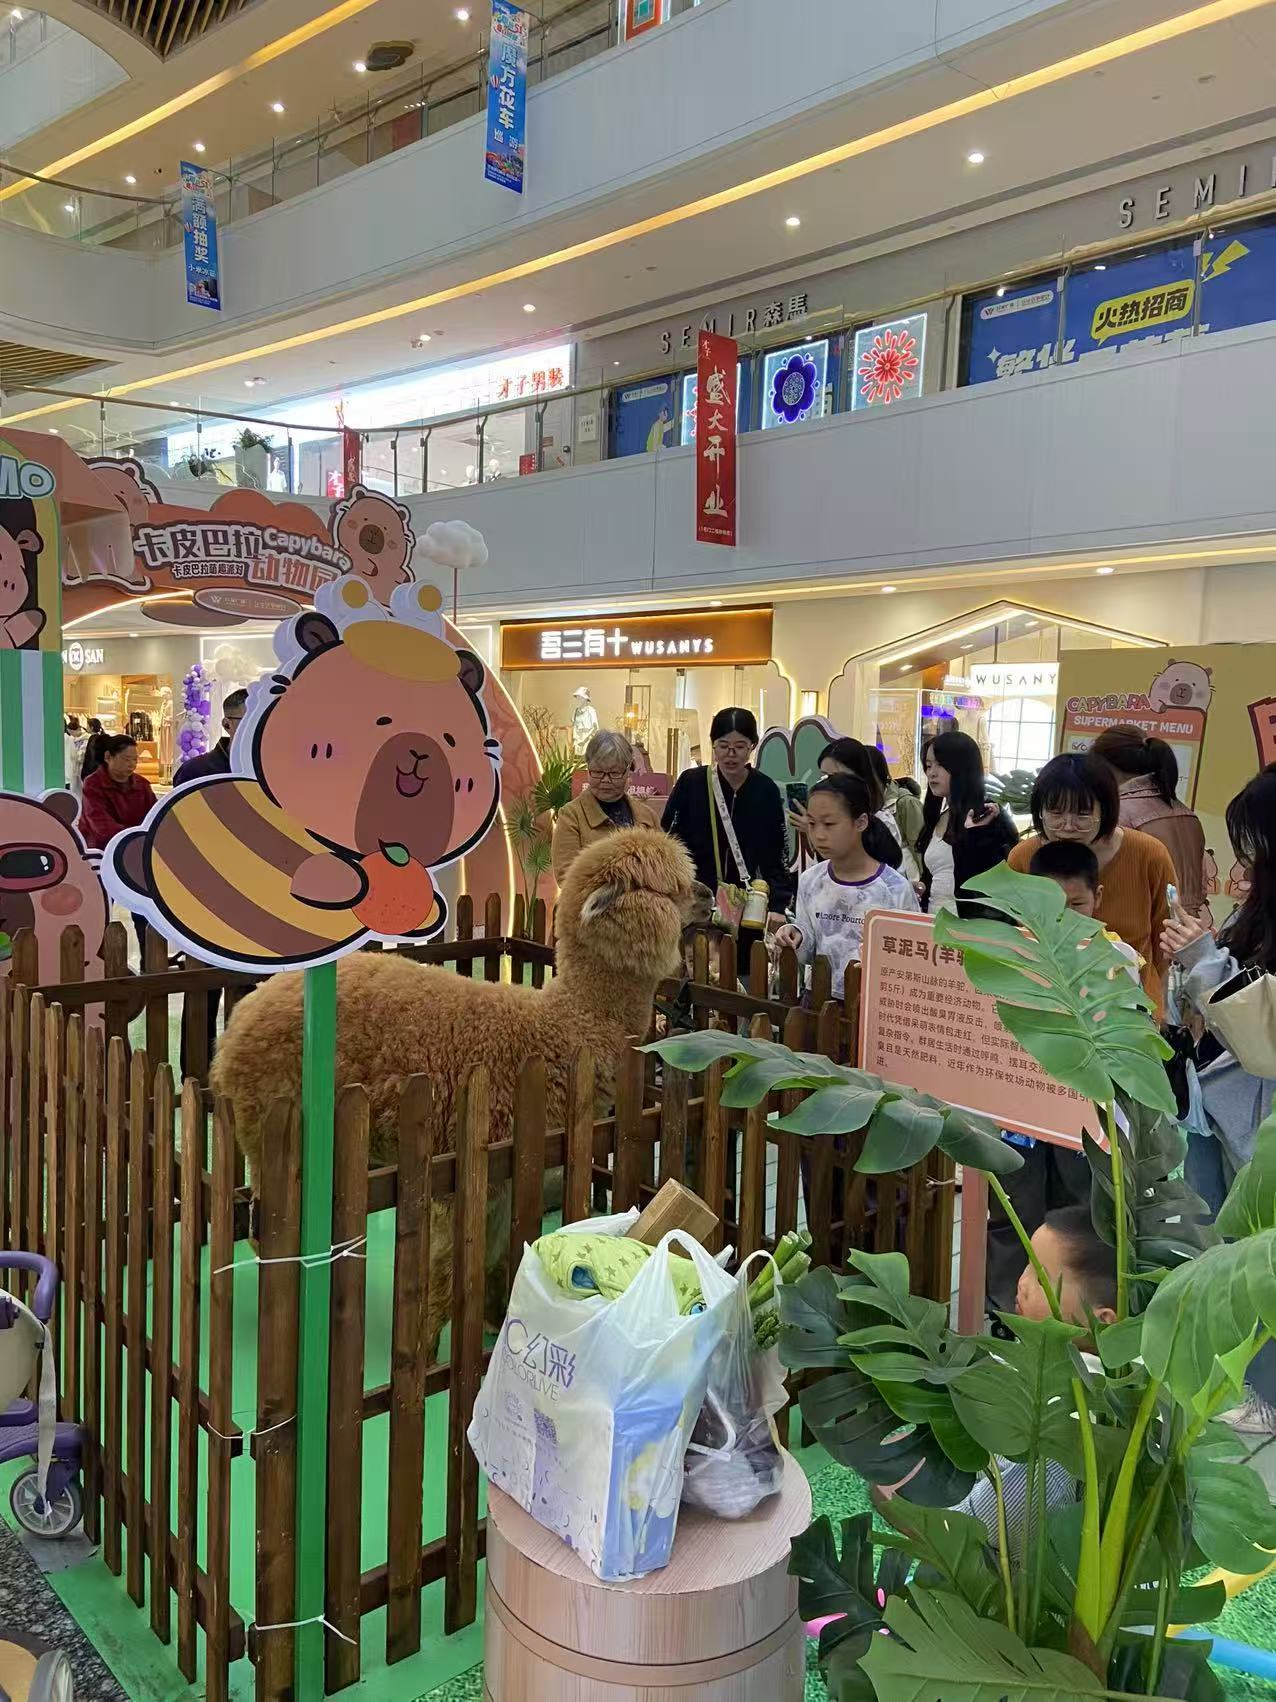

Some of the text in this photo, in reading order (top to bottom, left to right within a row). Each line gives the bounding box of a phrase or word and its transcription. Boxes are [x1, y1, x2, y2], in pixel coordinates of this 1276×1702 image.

[498, 43, 518, 130] 魔方花车
[192, 196, 209, 264] 满额抽奖
[661, 293, 808, 355] SEMIR 森馬
[1096, 286, 1190, 332] 火热招商
[703, 363, 731, 518] 盛大开业
[139, 527, 263, 565] 卡皮巴拉
[262, 527, 351, 570] Capybara
[173, 562, 245, 578] 卡皮巴拉萌趣派对
[250, 553, 337, 591] 动物园
[84, 648, 105, 664] SAN
[630, 637, 714, 656] WUSANYS
[975, 673, 1057, 688] WUSANY
[1067, 693, 1152, 714] CAPYBARA
[1160, 721, 1194, 735] MENU
